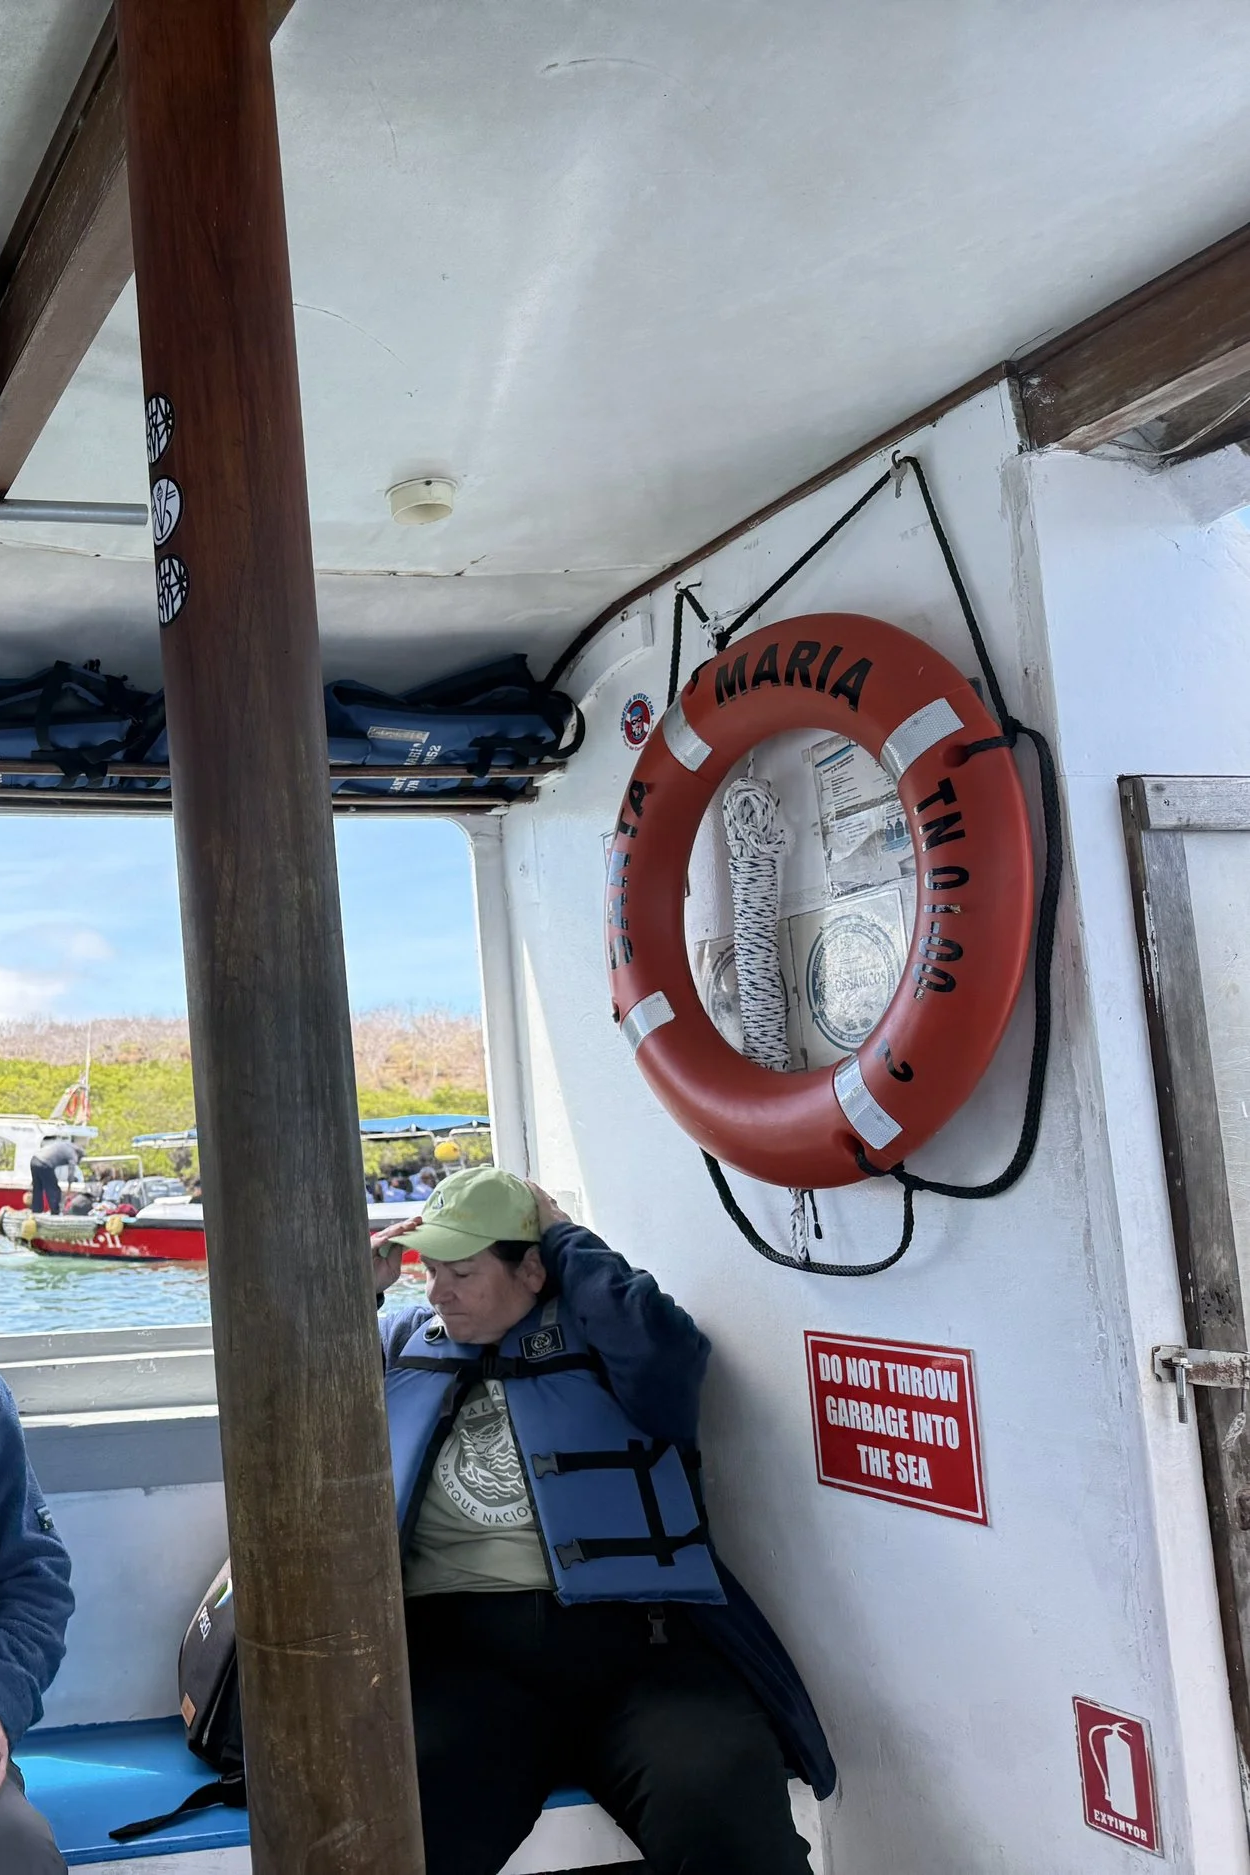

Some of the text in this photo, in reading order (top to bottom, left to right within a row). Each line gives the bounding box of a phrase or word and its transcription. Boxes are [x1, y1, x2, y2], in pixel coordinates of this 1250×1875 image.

[714, 640, 874, 713] MARIA
[913, 776, 967, 853] TN
[609, 780, 648, 970] SANTA
[818, 1352, 958, 1403] DO NOT THROW
[825, 1395, 960, 1450] GARBAGE INTO
[439, 1463, 477, 1516] PARQUE
[856, 1443, 933, 1490] THE SEA
[1093, 1808, 1148, 1842] EXTINTOR
